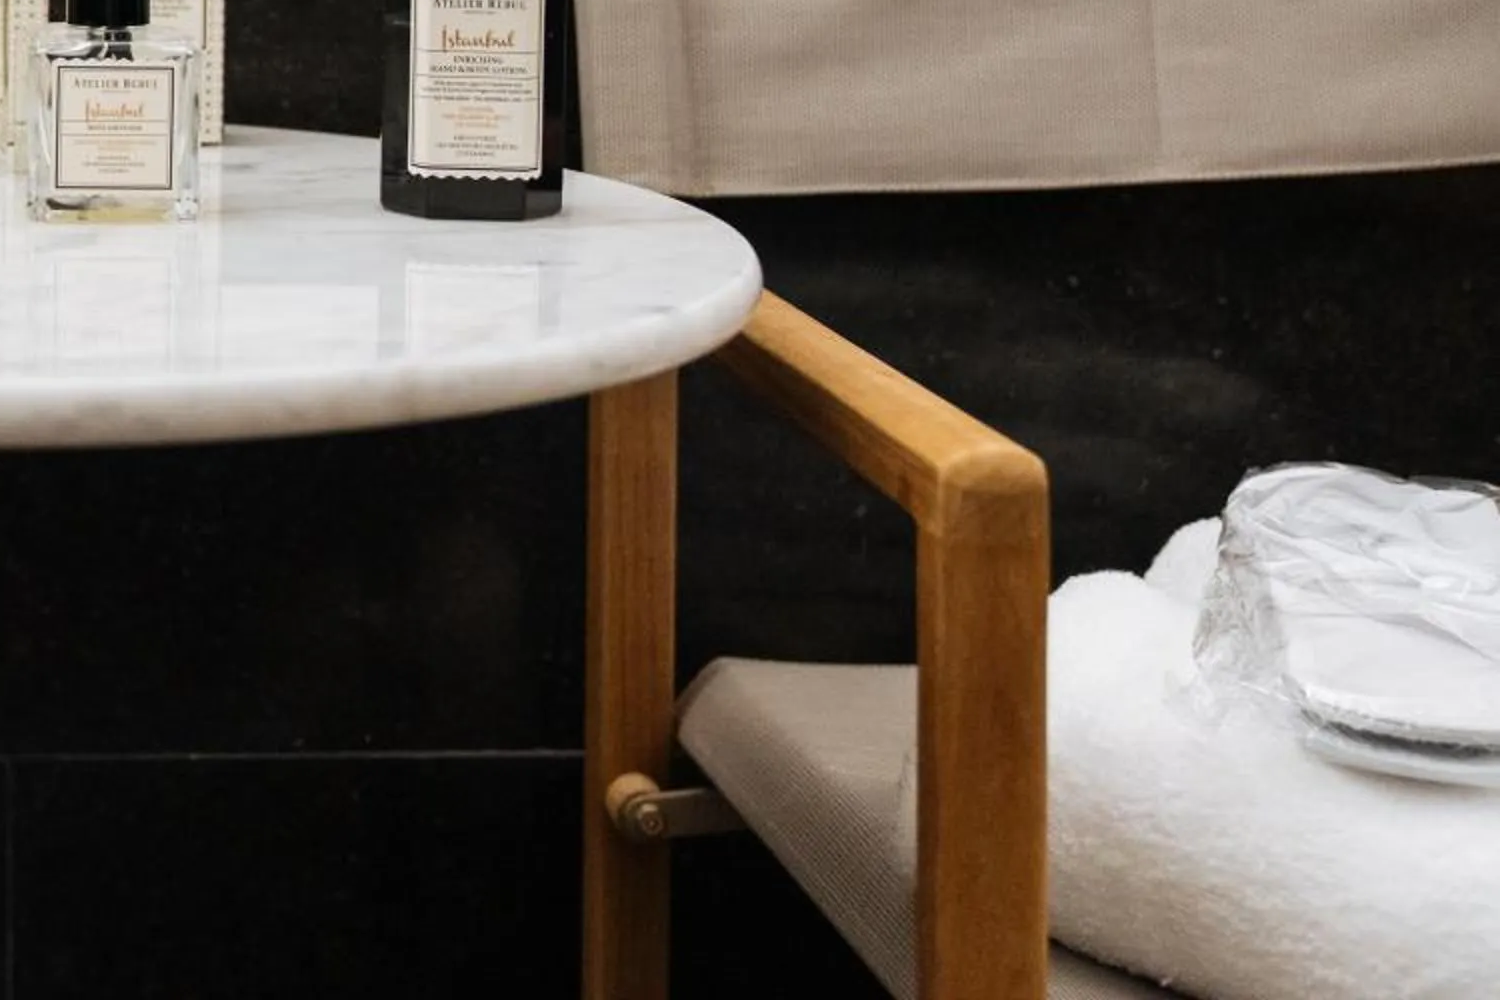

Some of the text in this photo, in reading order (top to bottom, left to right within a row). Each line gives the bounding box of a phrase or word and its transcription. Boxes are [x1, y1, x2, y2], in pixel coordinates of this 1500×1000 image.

[441, 25, 516, 53] Istanbul
[73, 77, 158, 91] ATELIER REBUL
